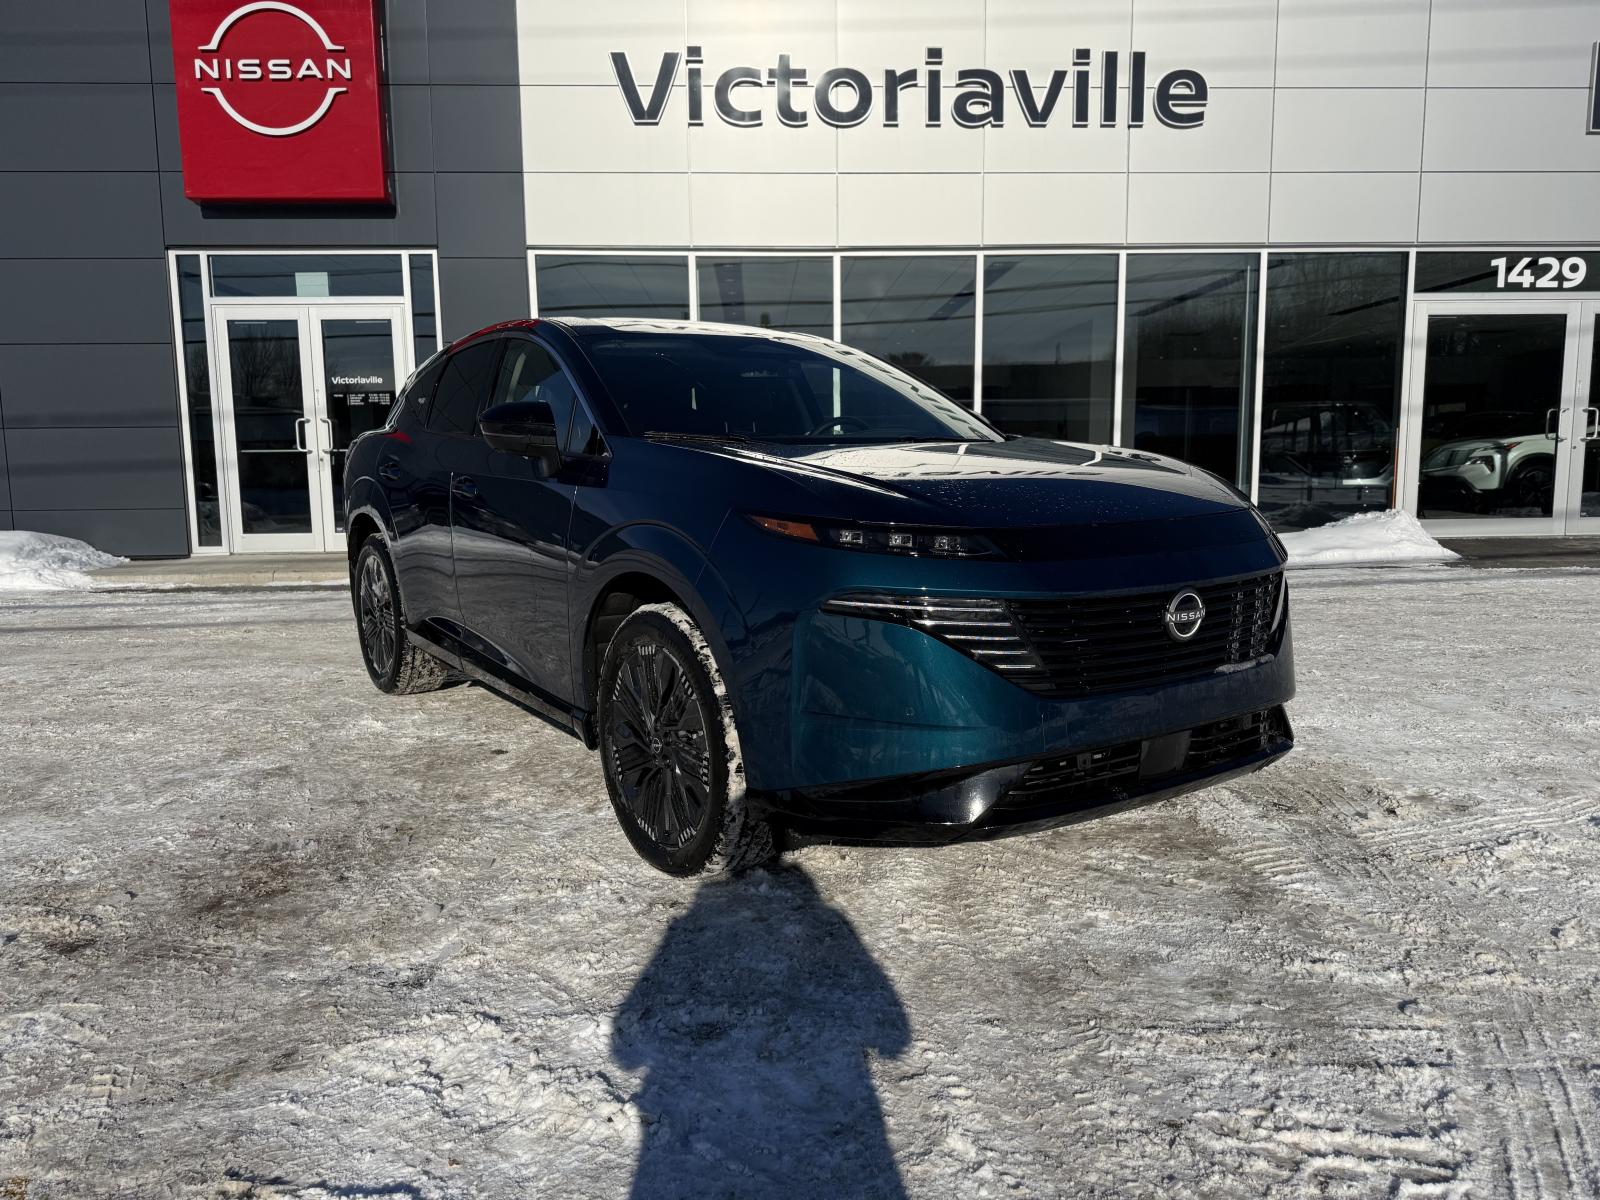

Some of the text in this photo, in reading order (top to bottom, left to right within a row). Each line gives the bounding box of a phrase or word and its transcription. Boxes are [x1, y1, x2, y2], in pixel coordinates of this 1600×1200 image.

[193, 58, 352, 81] NISSAN
[609, 45, 1209, 129] Victoriaville
[1490, 256, 1588, 289] 1429
[331, 376, 383, 384] Victoriaville
[1167, 608, 1206, 622] NISSAN
